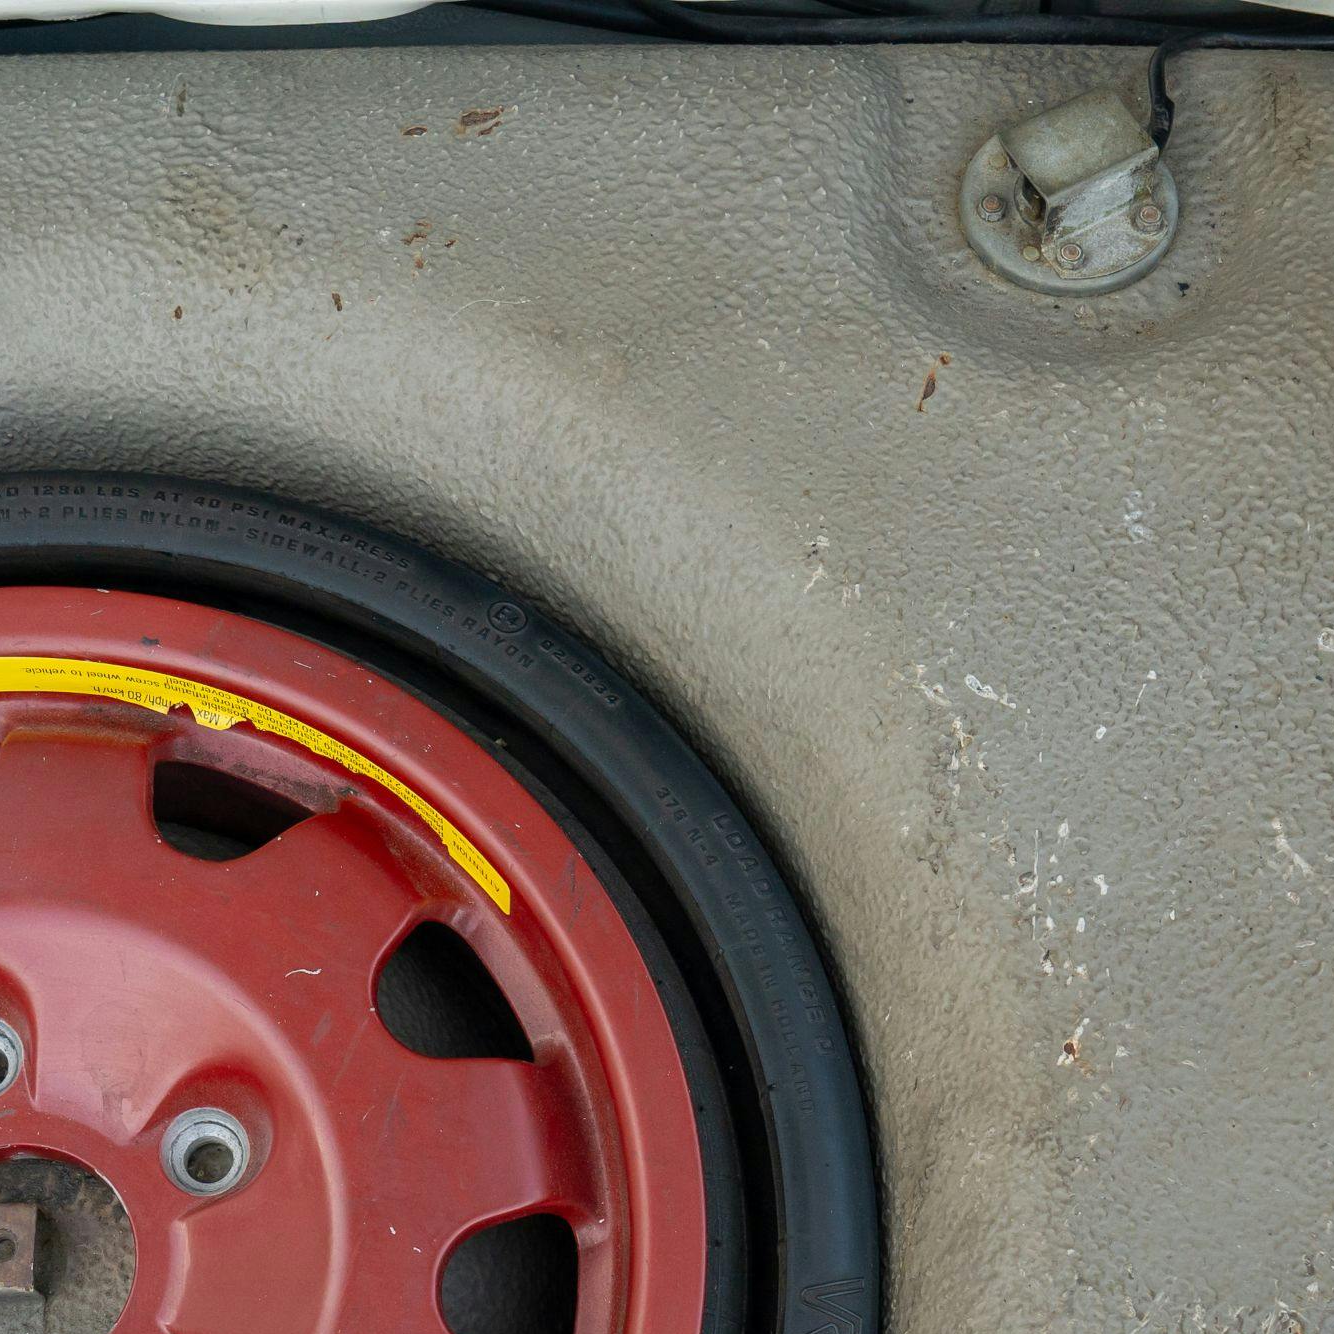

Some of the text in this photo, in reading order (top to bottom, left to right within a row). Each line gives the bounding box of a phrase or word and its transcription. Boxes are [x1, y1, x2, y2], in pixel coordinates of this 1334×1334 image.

[95, 482, 140, 501] LBS
[152, 487, 183, 506] AT
[191, 493, 222, 513] 40
[228, 499, 271, 523] PSI
[391, 576, 459, 621] PLIES
[457, 611, 537, 671] RAYON
[70, 668, 82, 676] to
[88, 670, 121, 682] wheel
[124, 674, 160, 687] screw
[126, 689, 142, 700] 80
[234, 695, 253, 708] not
[705, 809, 778, 901] LOAD
[719, 889, 770, 957] MADE
[764, 996, 821, 1116] HOLLAND
